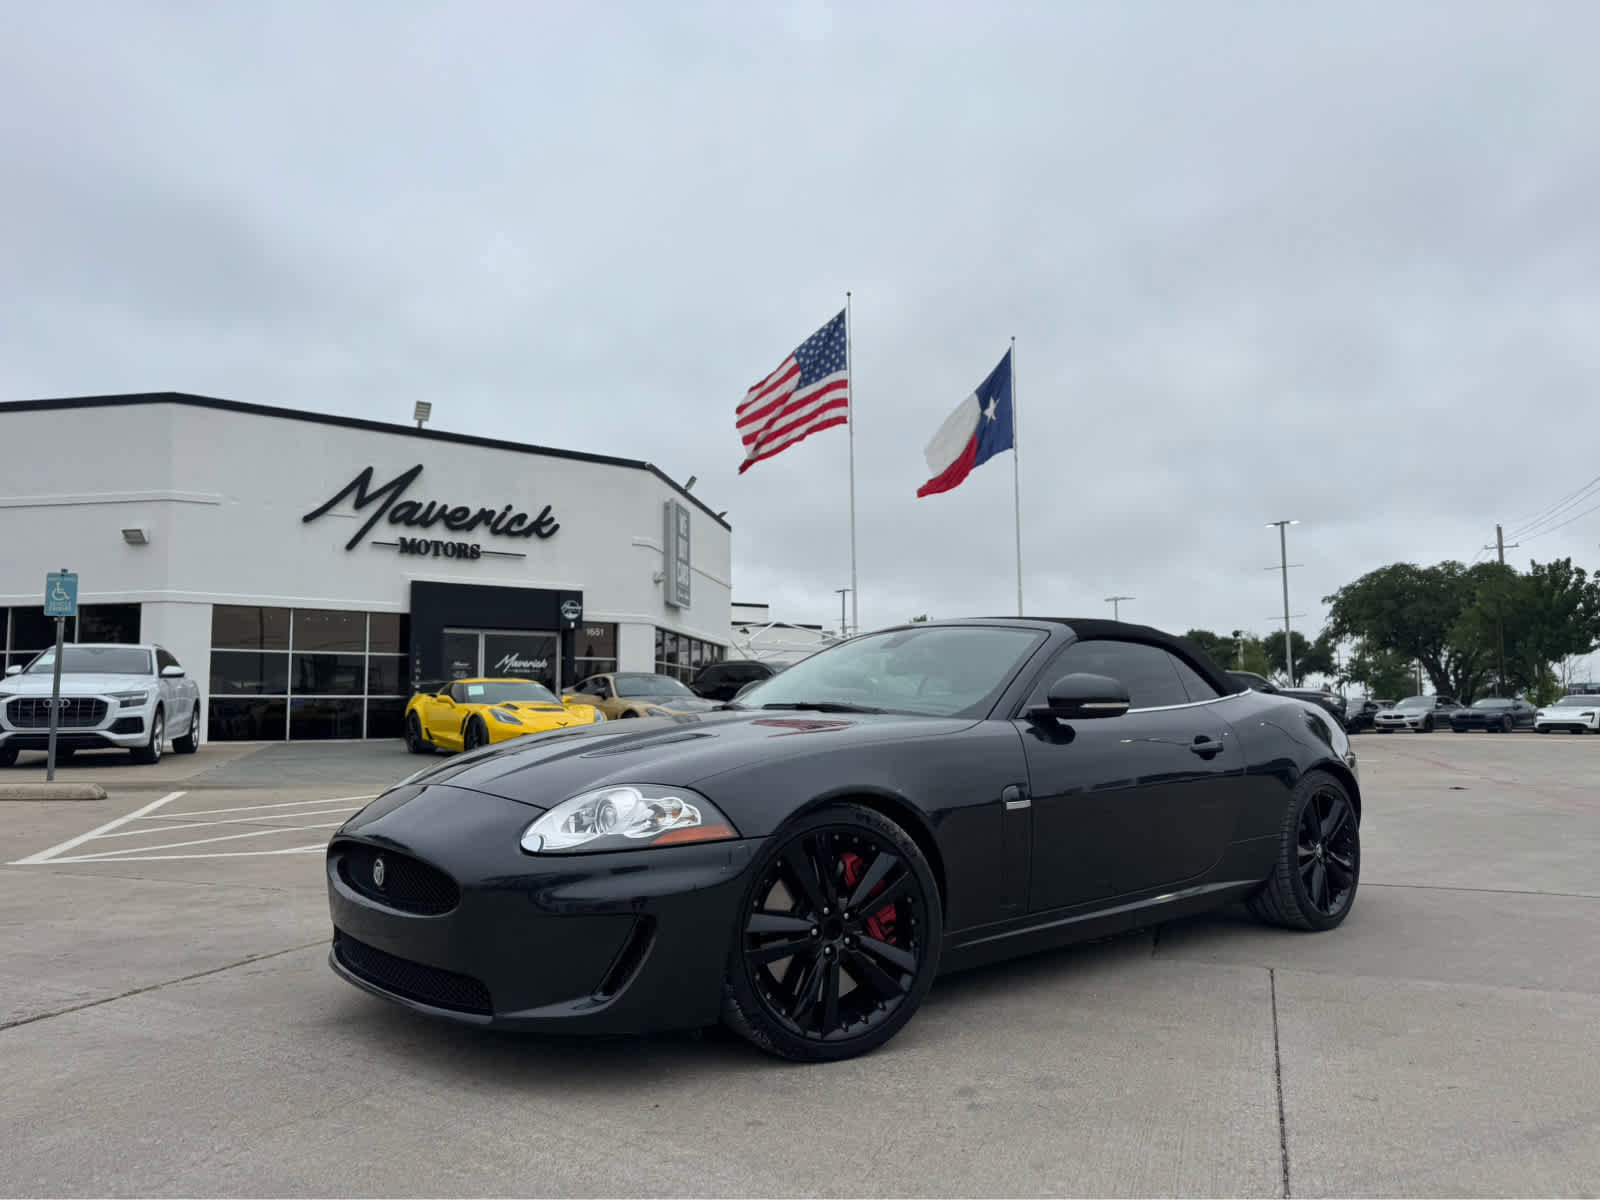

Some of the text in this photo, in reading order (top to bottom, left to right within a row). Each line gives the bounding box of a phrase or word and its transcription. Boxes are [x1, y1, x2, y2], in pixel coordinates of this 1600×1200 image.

[302, 463, 560, 551] Maverick
[398, 537, 481, 560] MOTORS
[494, 652, 548, 673] Maverick
